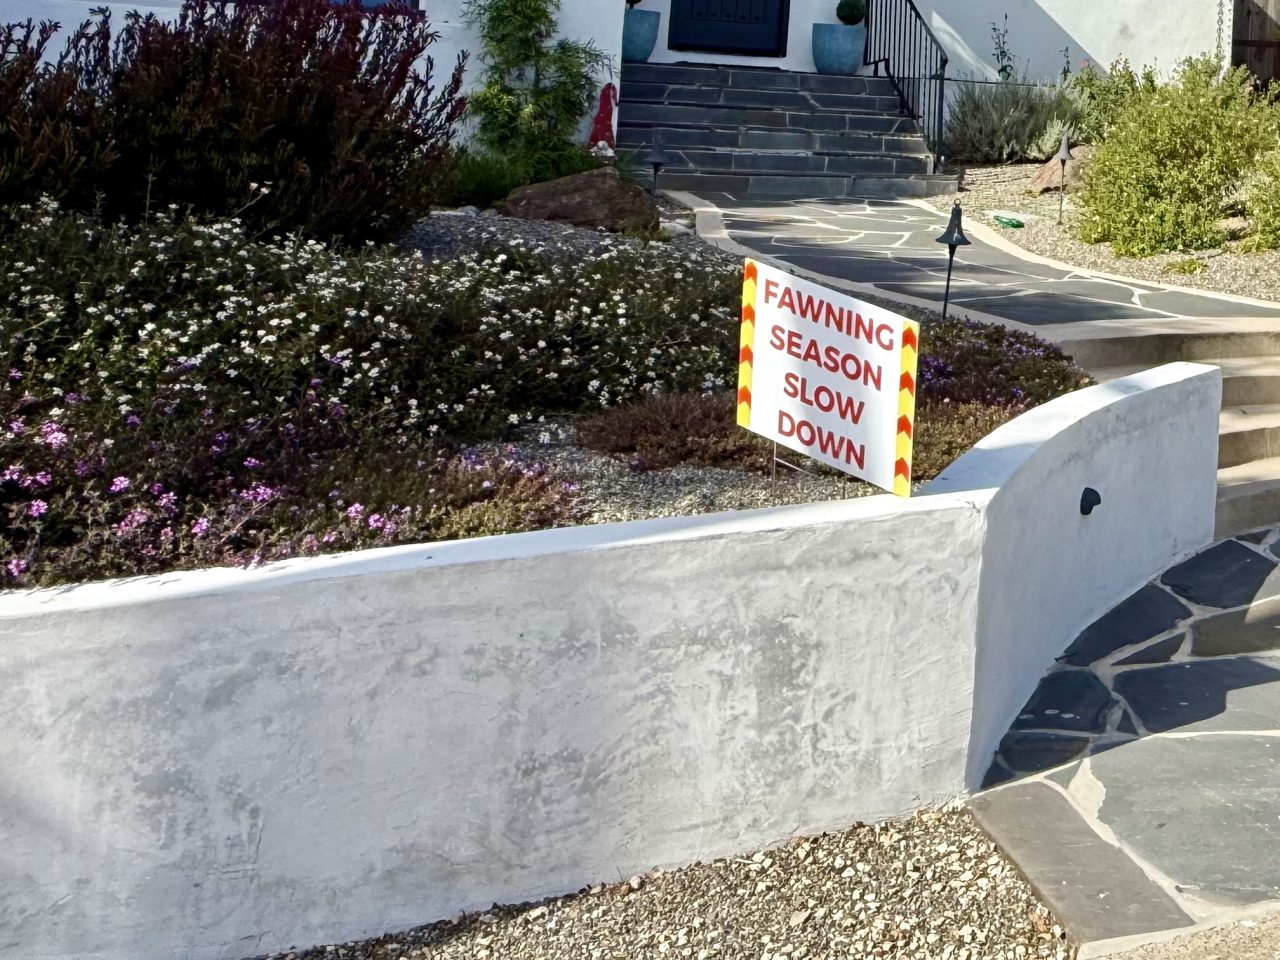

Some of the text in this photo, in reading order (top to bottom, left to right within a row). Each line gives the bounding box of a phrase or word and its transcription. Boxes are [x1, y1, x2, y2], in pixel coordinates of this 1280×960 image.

[764, 279, 894, 351] FAWNING
[770, 325, 882, 391] SEASON
[784, 373, 865, 425] SLOW
[778, 410, 865, 470] DOWN
